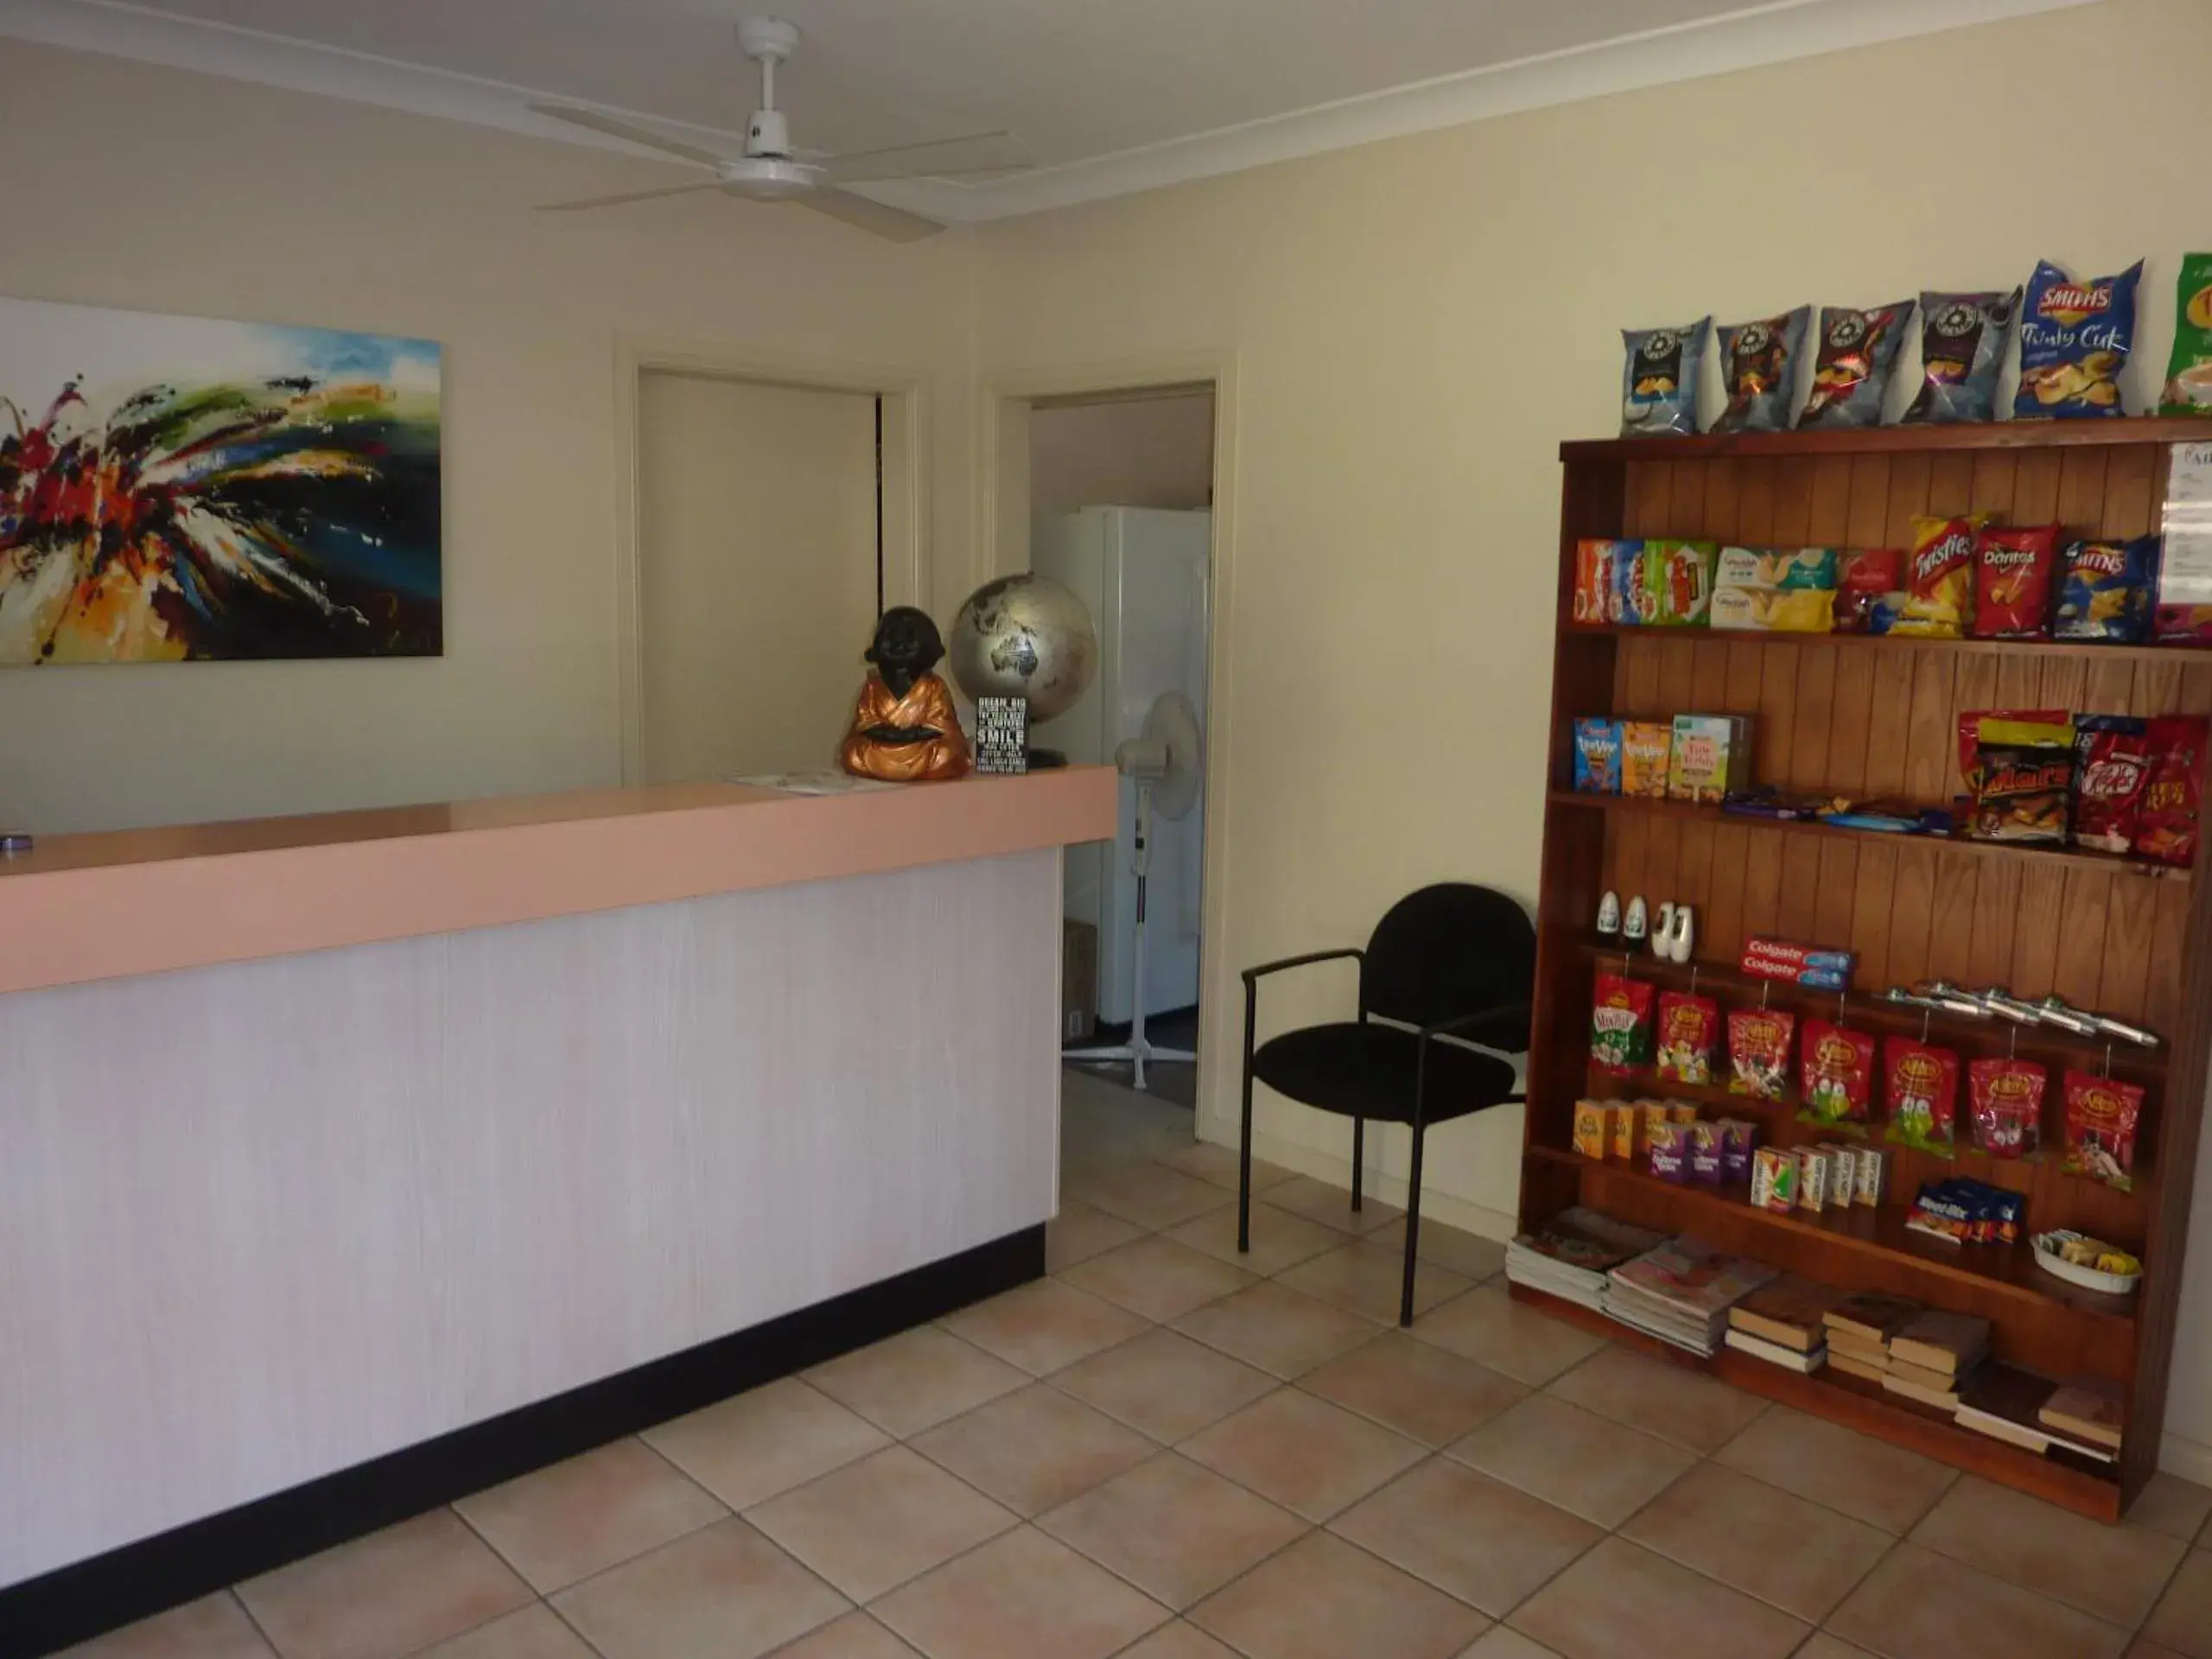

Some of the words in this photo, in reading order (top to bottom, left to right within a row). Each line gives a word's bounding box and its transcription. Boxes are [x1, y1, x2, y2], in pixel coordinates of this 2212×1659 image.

[2022, 322, 2075, 348] Thinly
[2080, 325, 2130, 352] Cut
[1915, 532, 1971, 580] Twisties
[1983, 550, 2036, 566] Doritos
[977, 729, 1025, 745] SMILE
[1747, 939, 1803, 960] Colgate
[1743, 956, 1798, 976] Colgate
